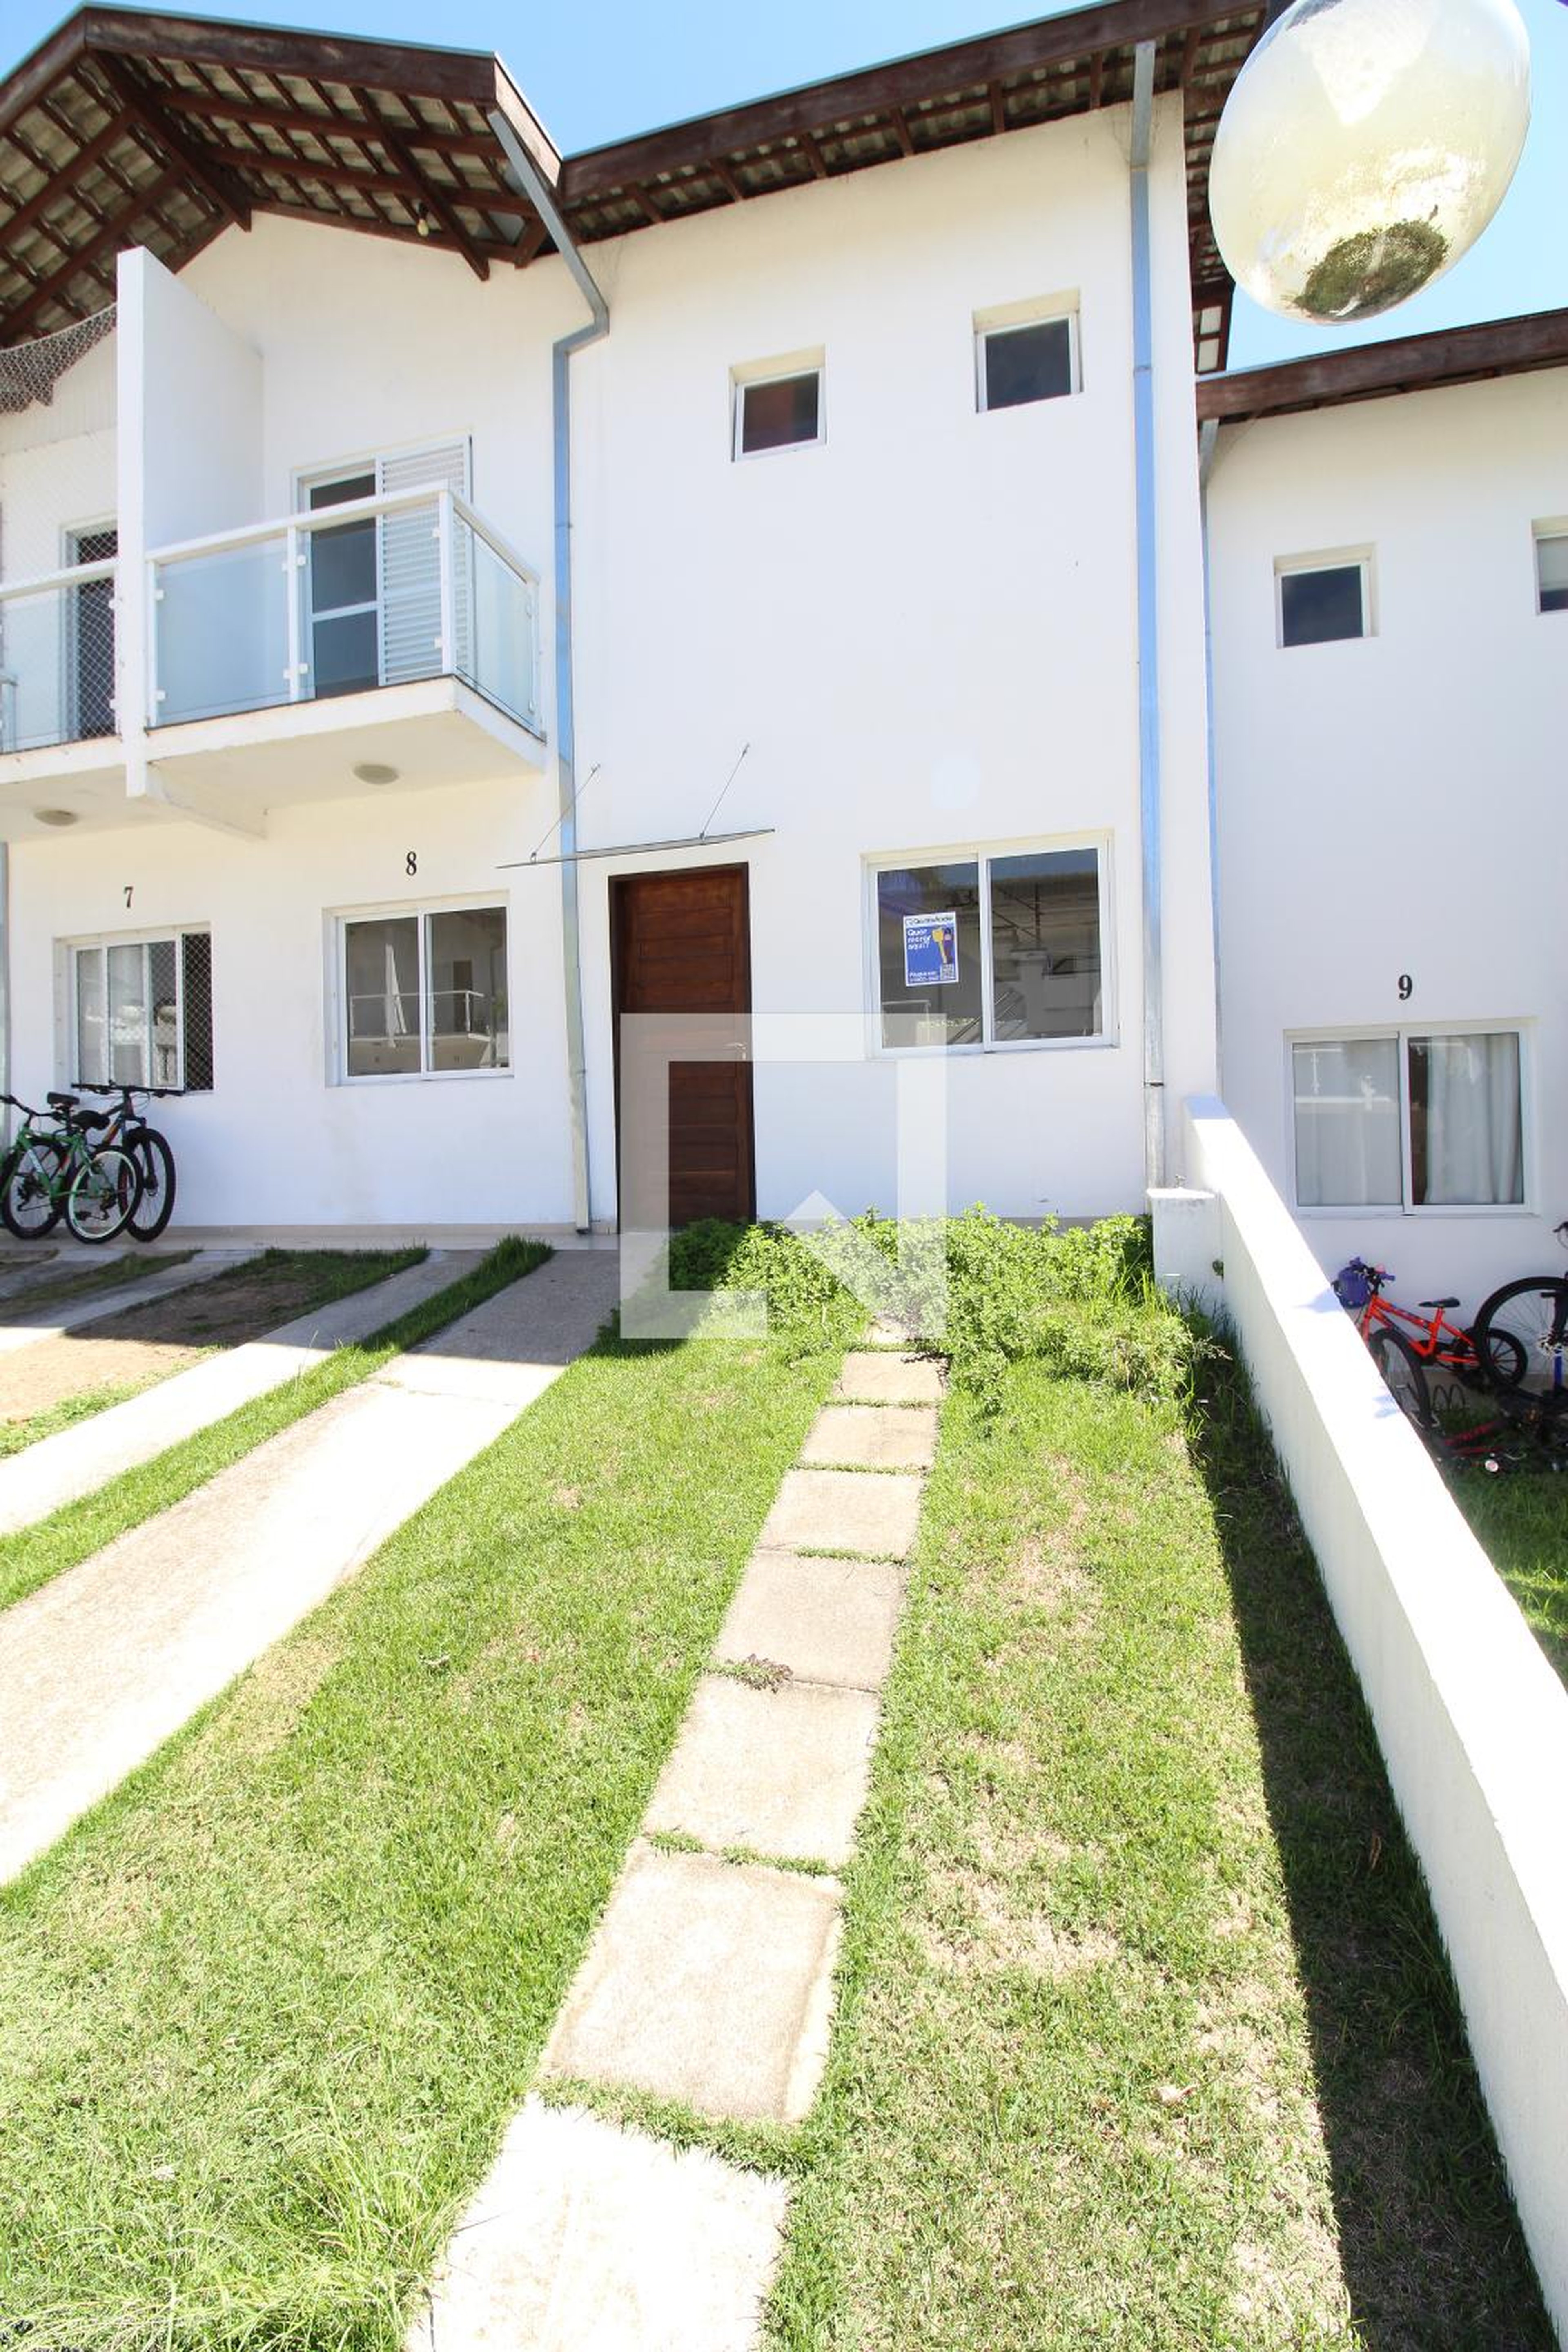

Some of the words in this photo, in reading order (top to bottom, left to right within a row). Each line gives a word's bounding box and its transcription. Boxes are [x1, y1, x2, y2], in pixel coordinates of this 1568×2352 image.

[406, 851, 417, 876] 8
[123, 886, 133, 908] 7
[1398, 974, 1412, 1000] 9
